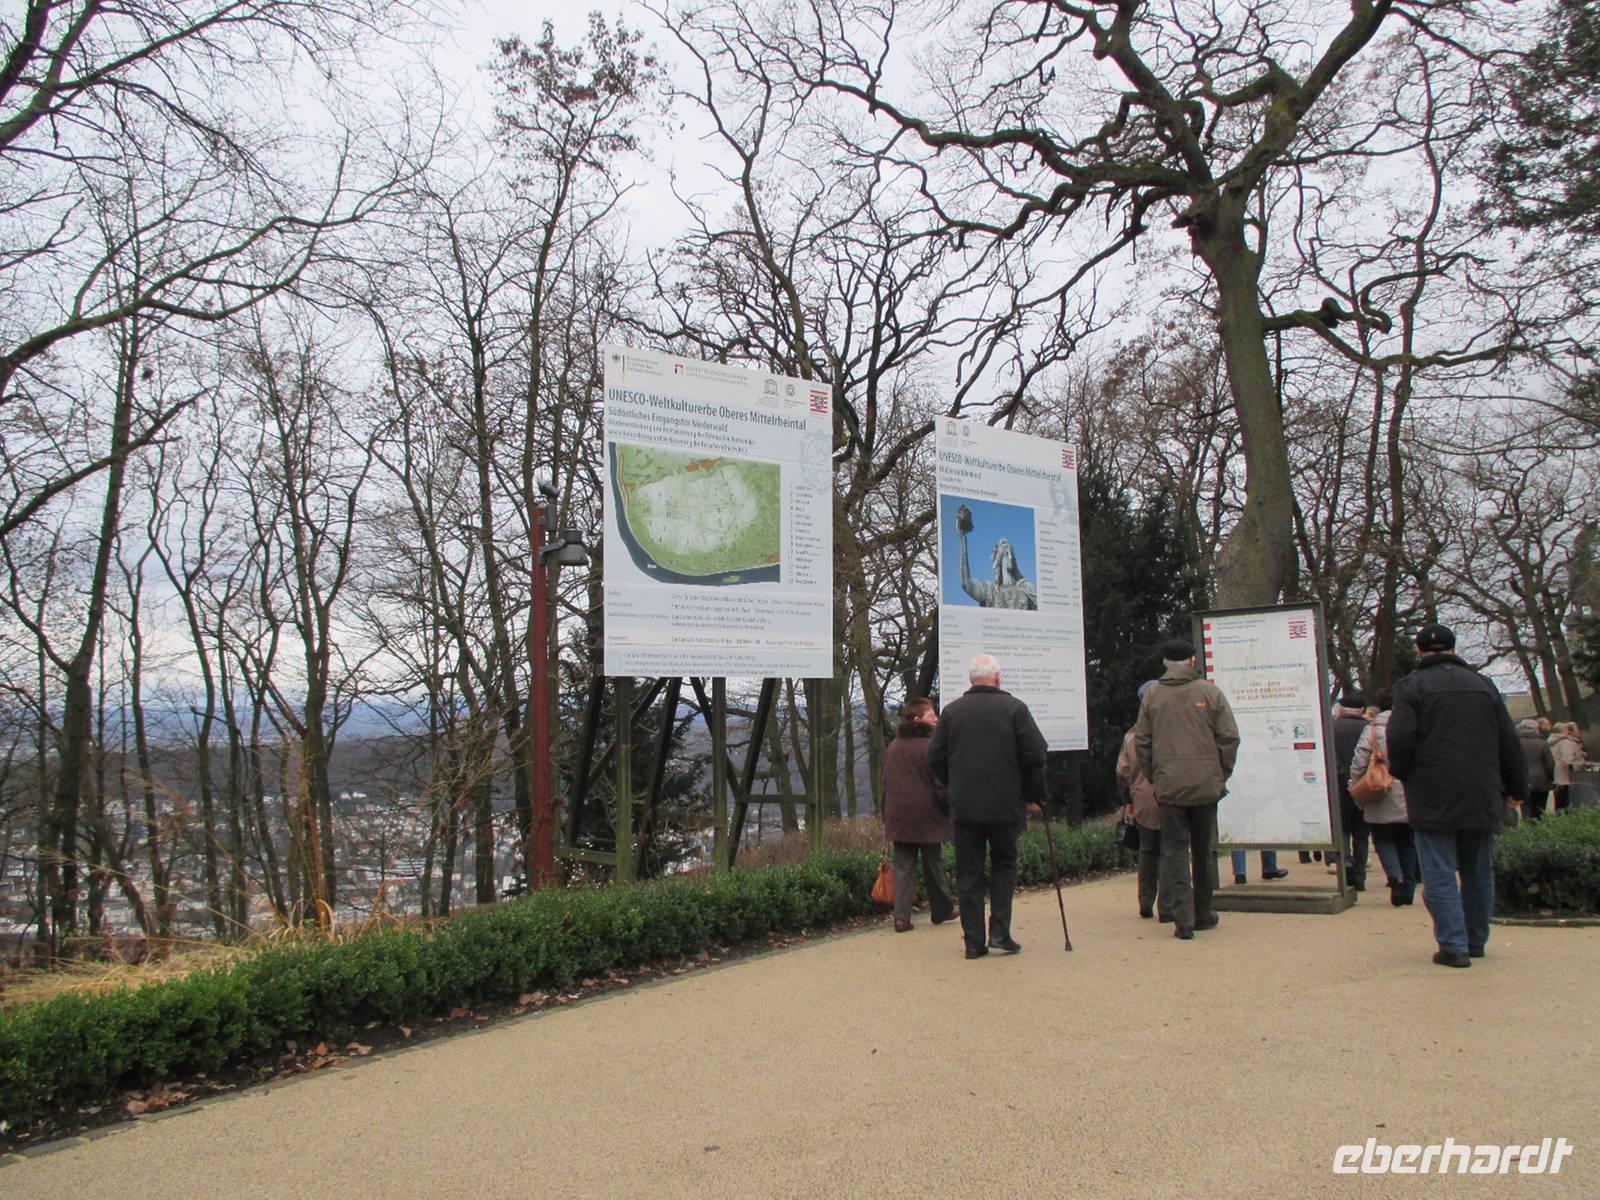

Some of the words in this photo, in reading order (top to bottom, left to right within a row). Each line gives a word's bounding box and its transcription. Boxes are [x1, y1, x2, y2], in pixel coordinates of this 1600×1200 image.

[608, 388, 718, 416] UNESCO-Weltkulturerbe
[719, 403, 748, 422] Oberes
[749, 411, 807, 431] Mittelrheintal
[652, 412, 691, 428] Eingangstor
[692, 418, 728, 432] Niederwald
